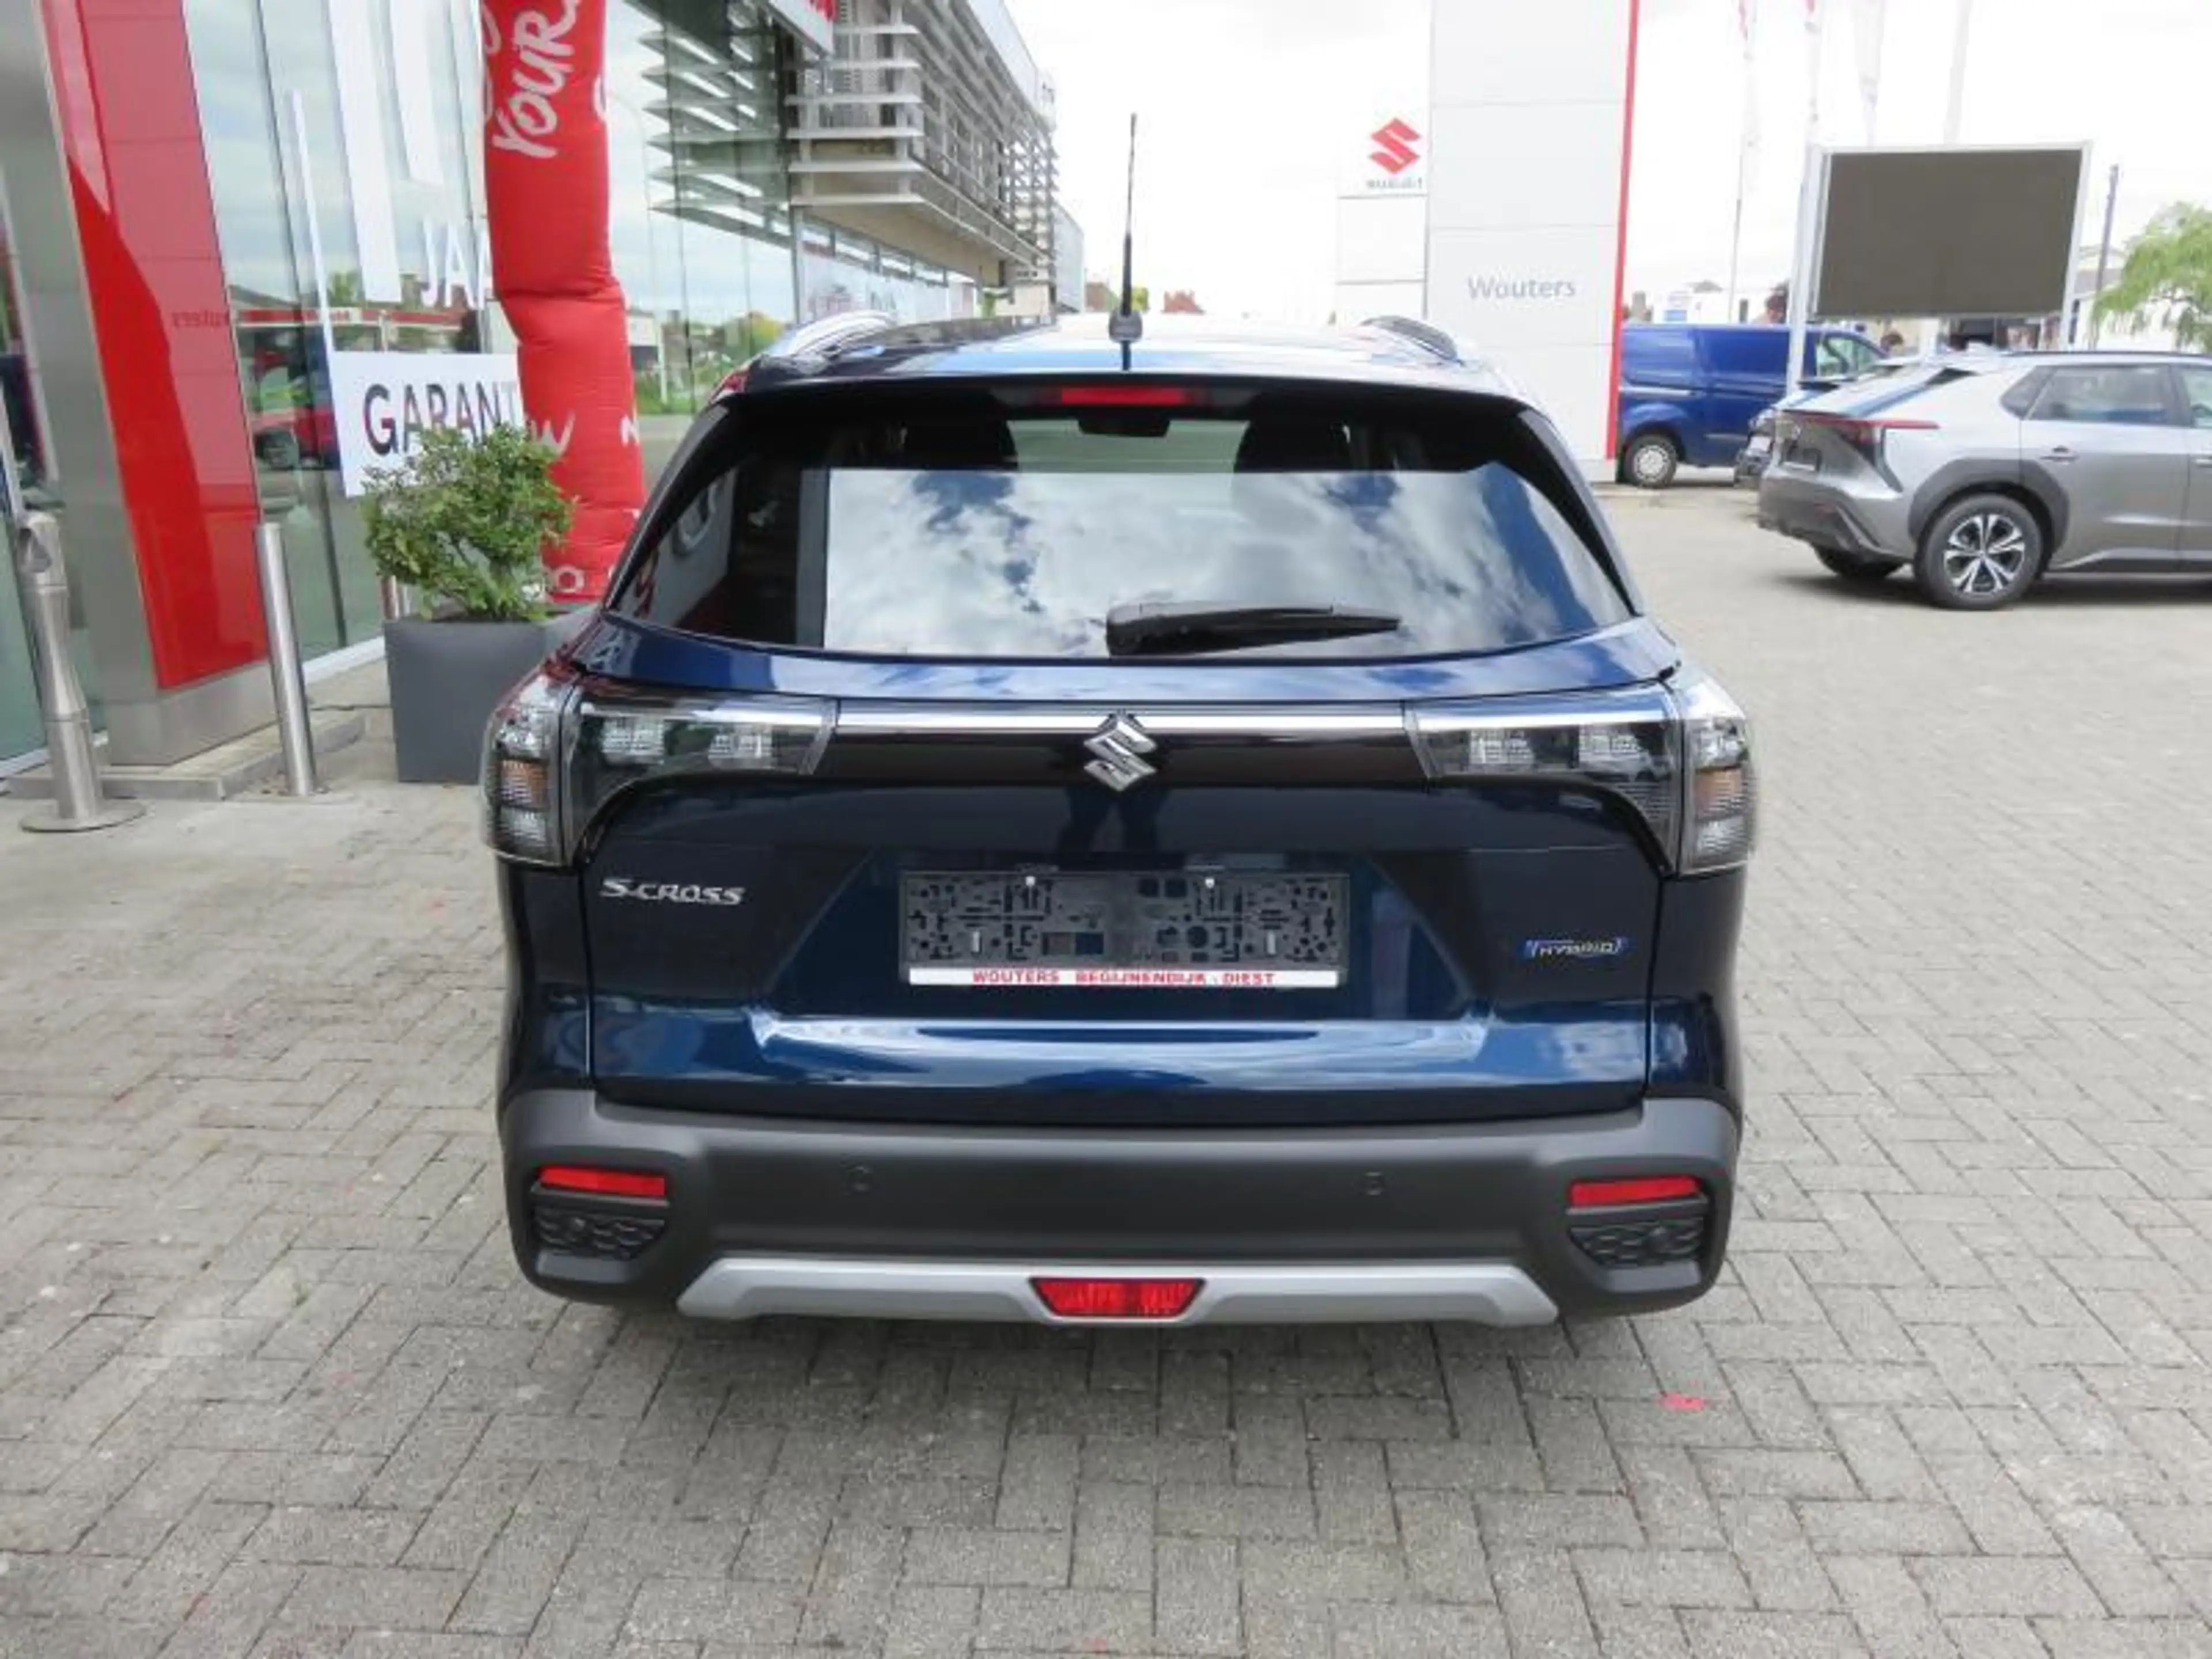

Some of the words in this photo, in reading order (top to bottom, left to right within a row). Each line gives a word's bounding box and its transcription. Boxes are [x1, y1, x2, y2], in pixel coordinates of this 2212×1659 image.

[492, 0, 577, 158] YOUR
[1468, 274, 1575, 300] Wouters
[973, 970, 1060, 983] WOUTERS
[1223, 973, 1275, 986] DIEST
